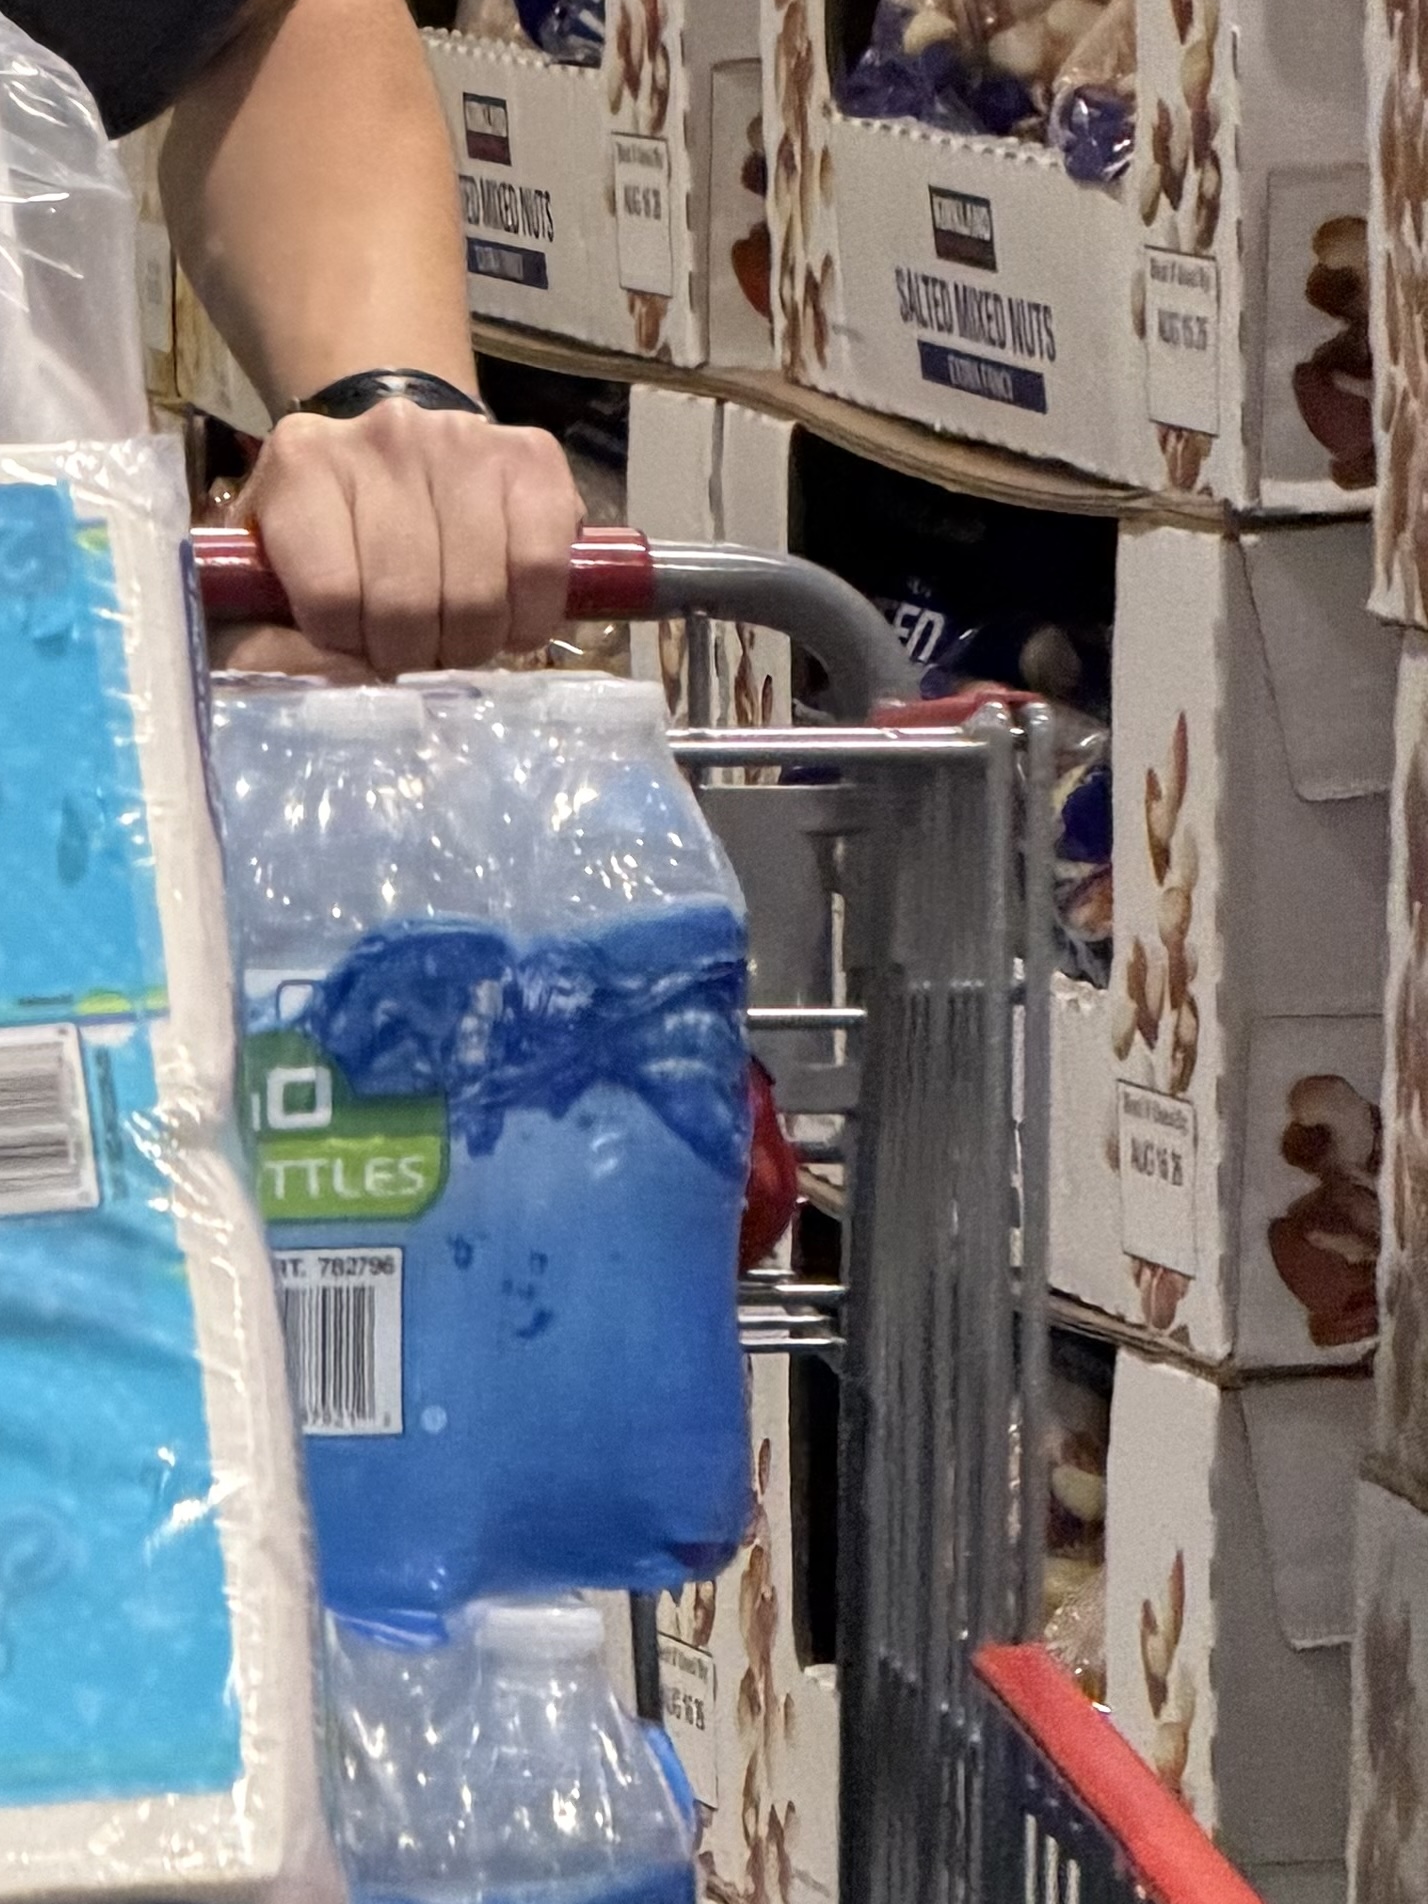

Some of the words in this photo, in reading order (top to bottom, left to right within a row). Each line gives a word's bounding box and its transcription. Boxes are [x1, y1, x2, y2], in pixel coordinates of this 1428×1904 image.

[893, 265, 955, 335] SALTED
[954, 280, 1007, 350] MIXED
[1007, 295, 1057, 363] NUTS
